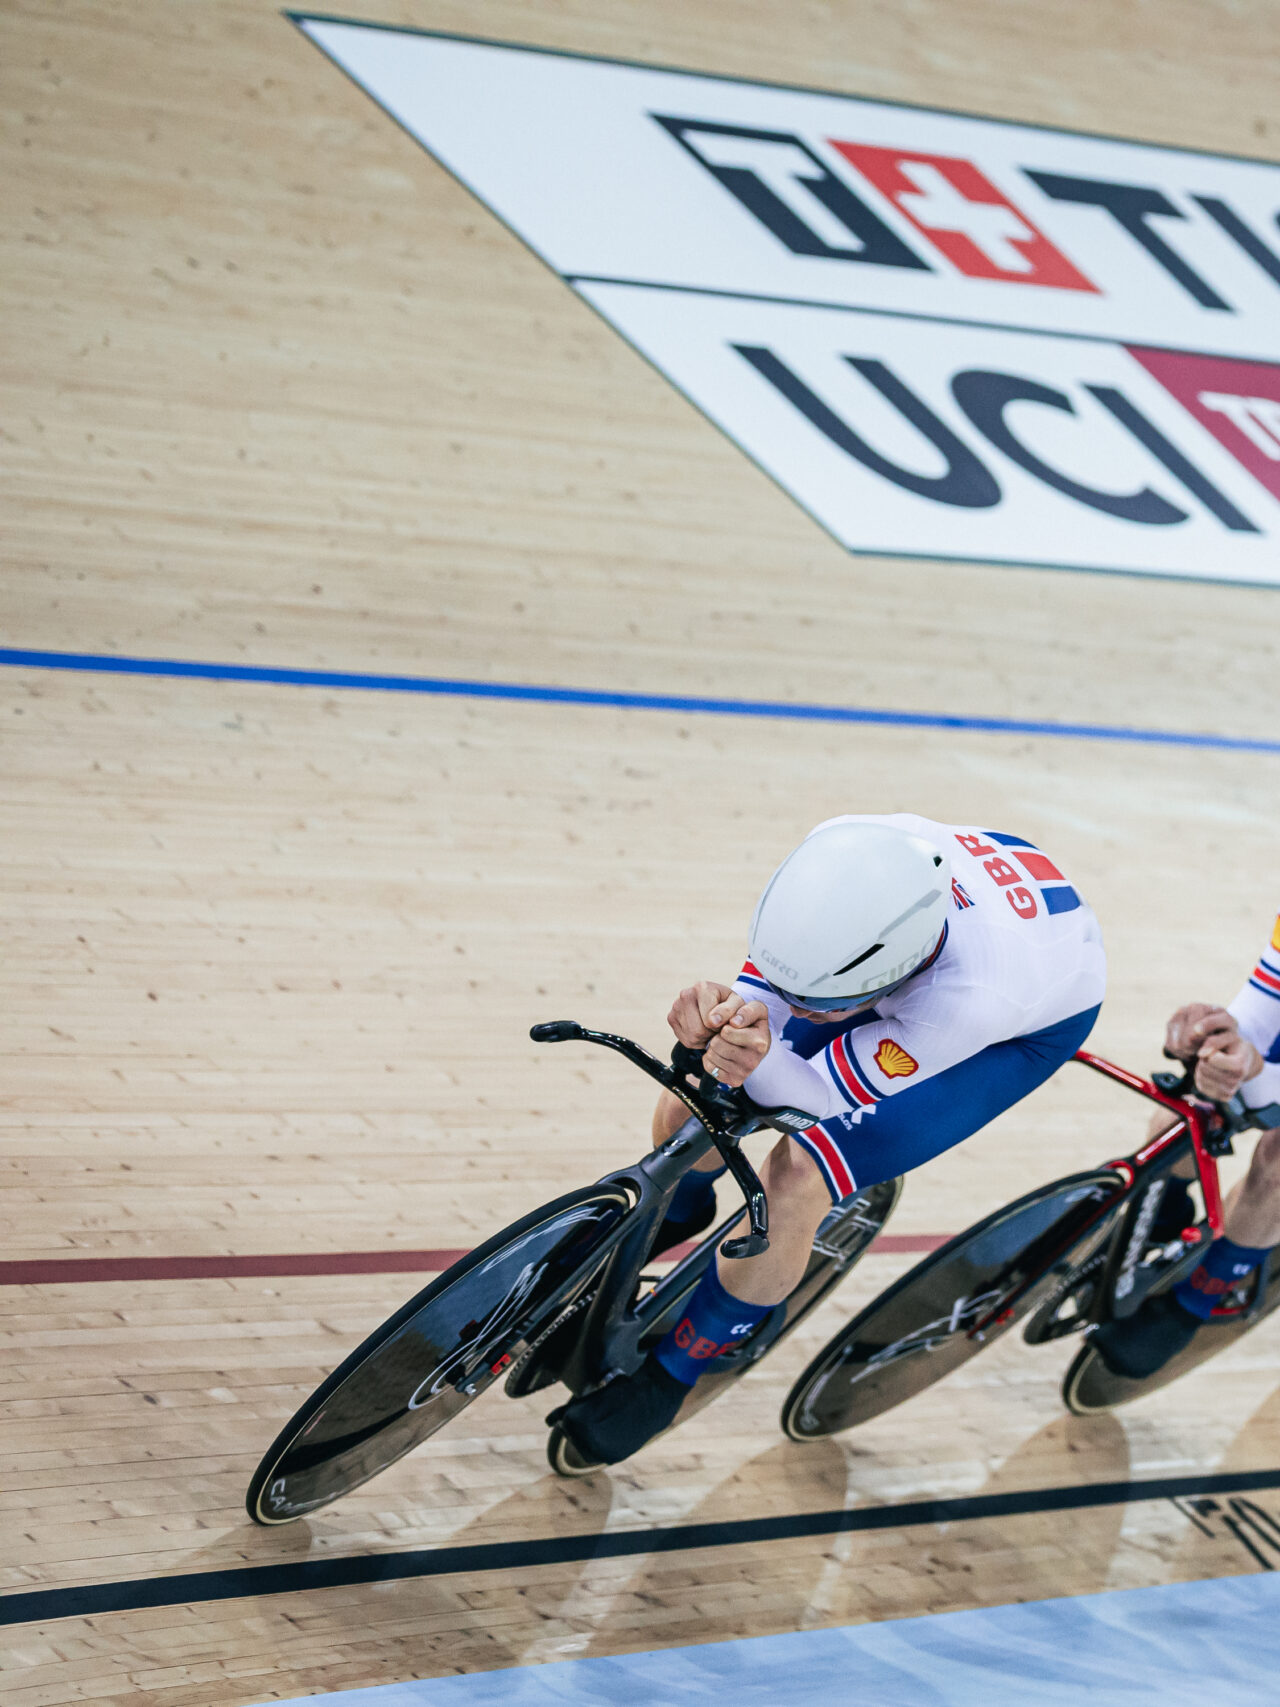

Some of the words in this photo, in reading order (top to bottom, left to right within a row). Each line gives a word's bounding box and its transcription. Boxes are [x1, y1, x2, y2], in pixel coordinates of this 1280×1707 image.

[727, 341, 1264, 535] UCI
[954, 834, 1038, 920] GBR
[760, 949, 799, 981] GIRO
